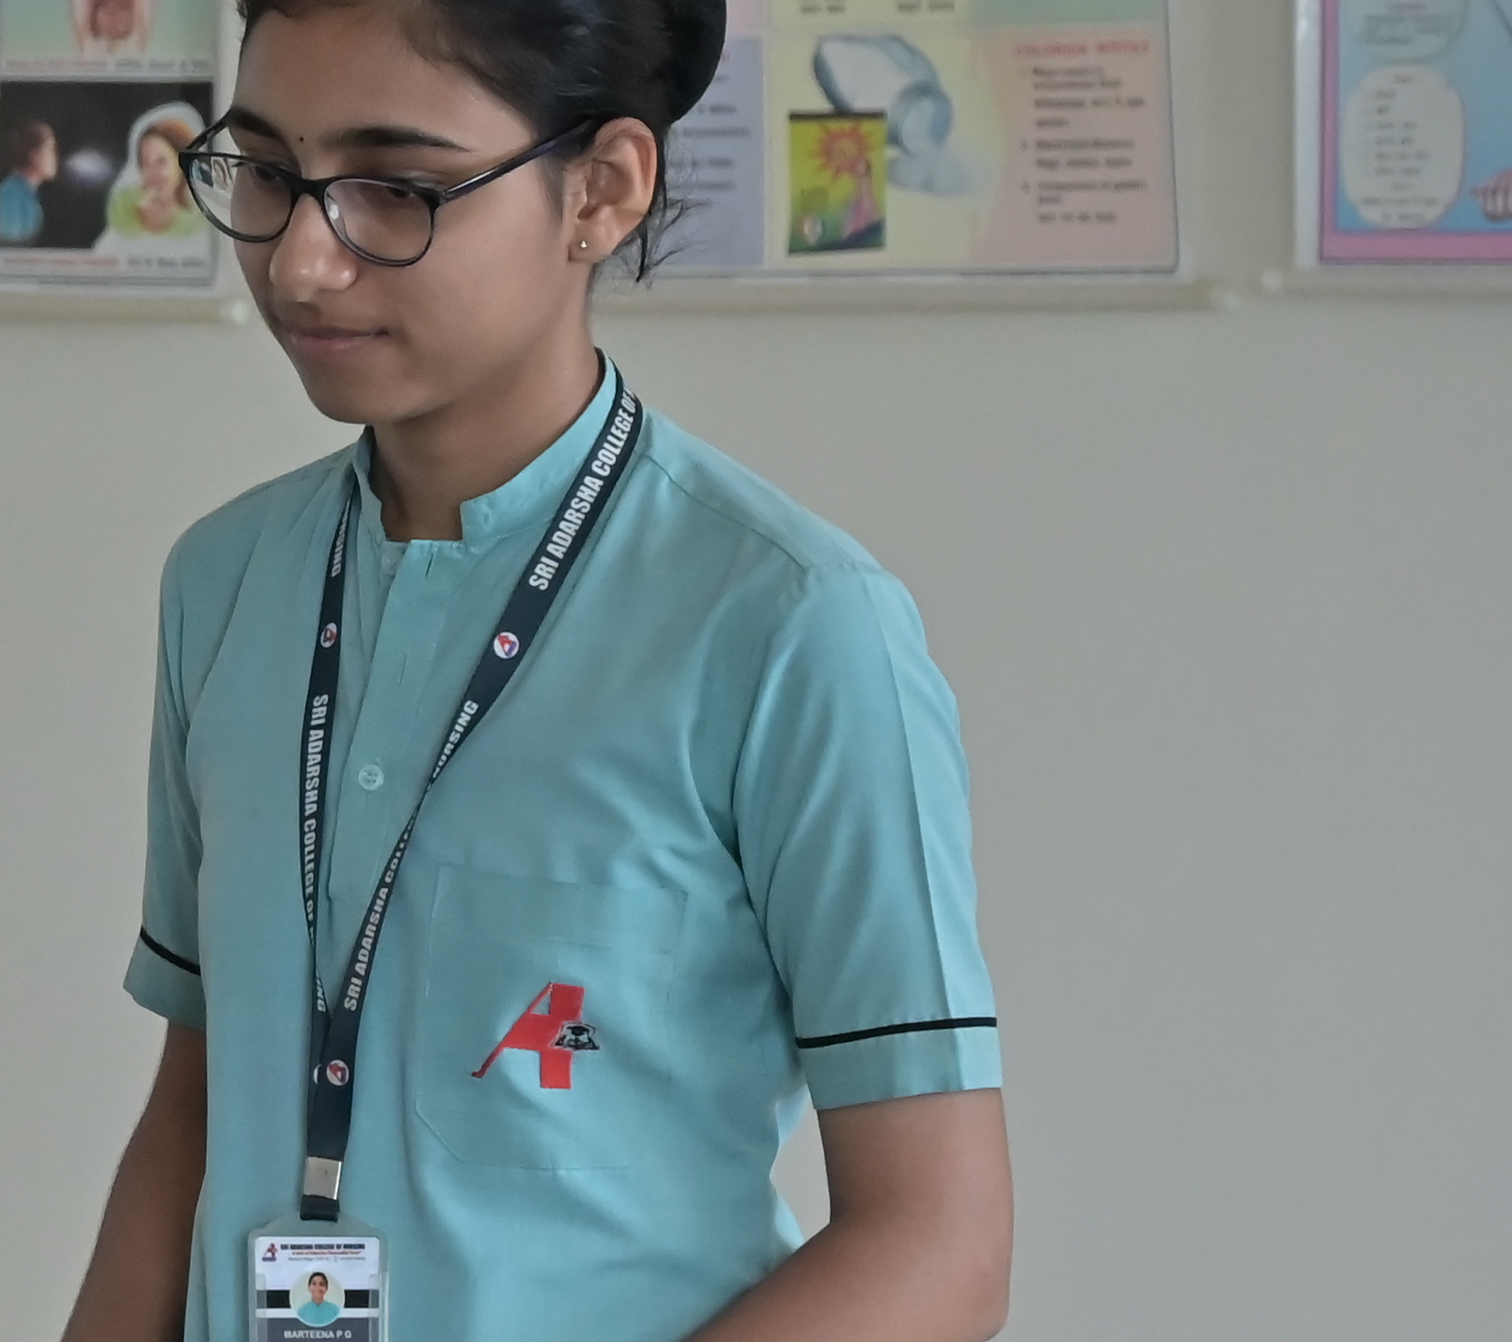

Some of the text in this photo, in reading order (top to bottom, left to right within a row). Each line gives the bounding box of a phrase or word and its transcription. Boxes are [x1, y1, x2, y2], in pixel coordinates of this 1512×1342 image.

[529, 555, 560, 591] SRI
[547, 475, 604, 559] ADARSHA
[591, 409, 636, 477] COLLEGE
[313, 693, 329, 725] SRI
[305, 729, 326, 824] ADARSHA
[304, 823, 317, 895] COLLEGE
[344, 974, 362, 1013] SRI
[355, 885, 389, 977] ADARSHA
[283, 1329, 334, 1339] MARTEENA
[336, 1329, 344, 1339] P
